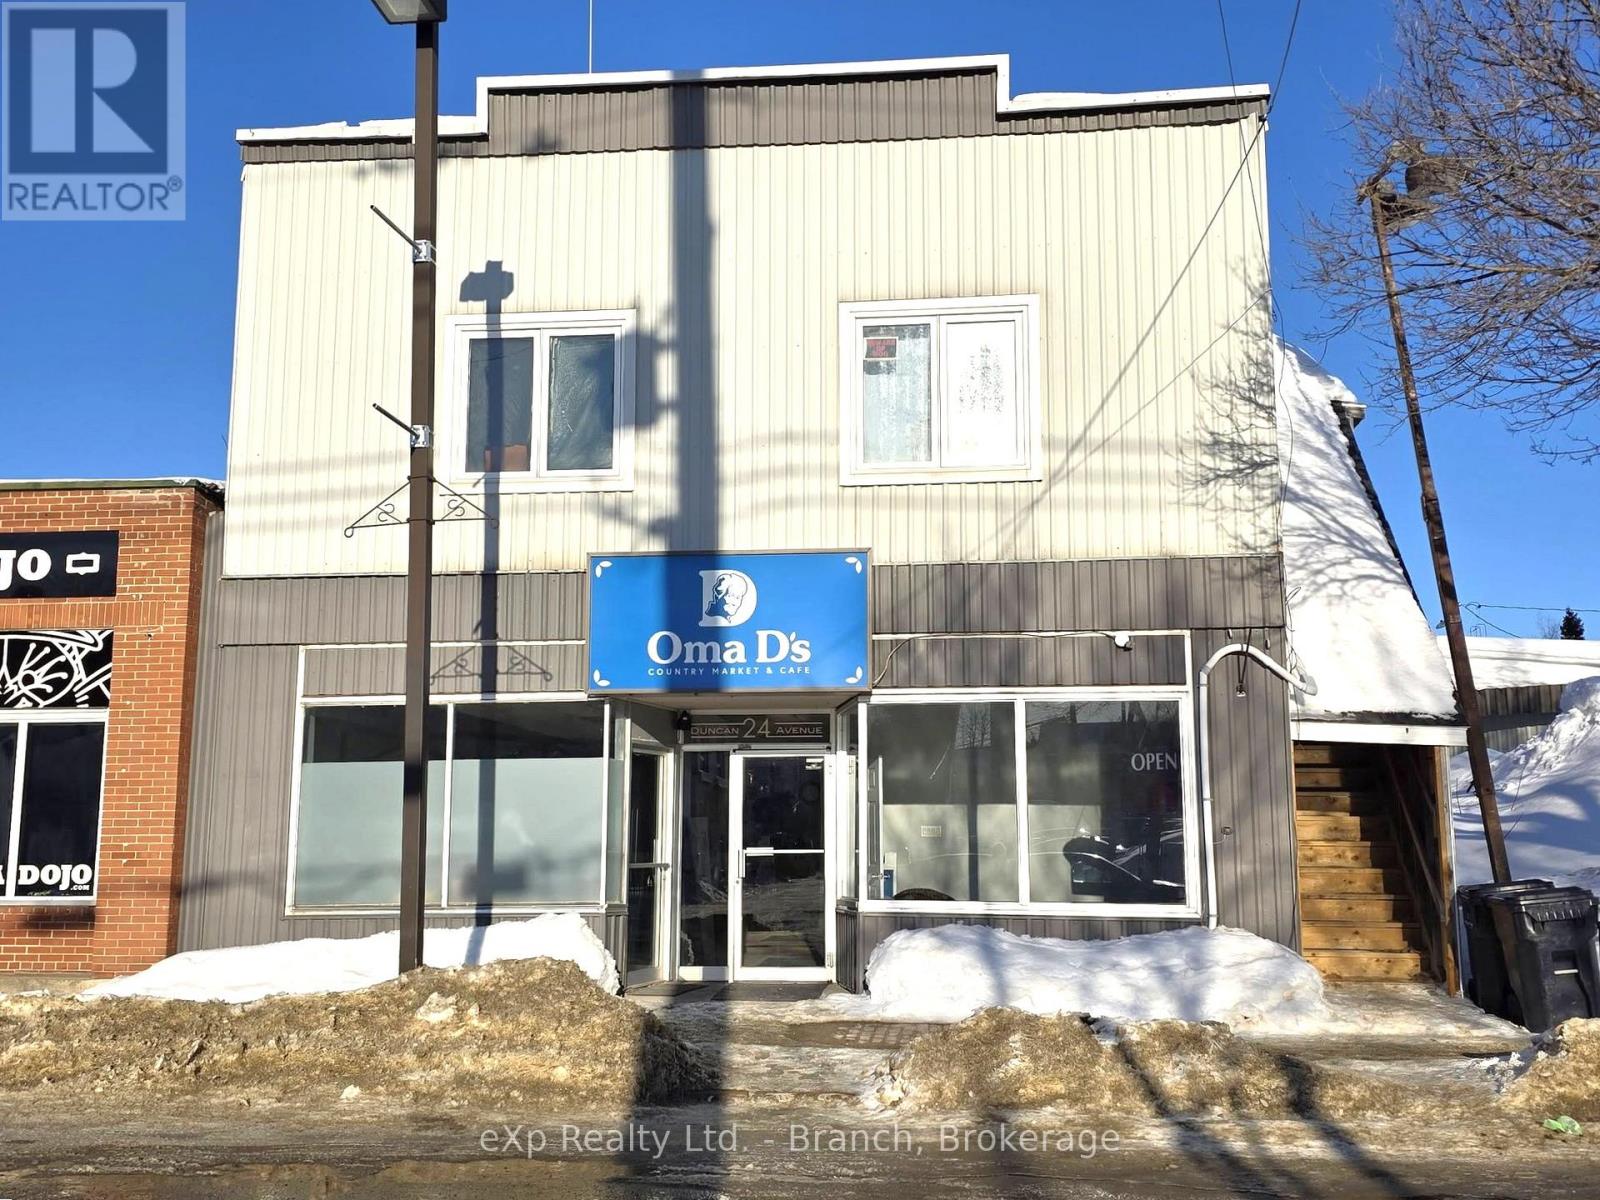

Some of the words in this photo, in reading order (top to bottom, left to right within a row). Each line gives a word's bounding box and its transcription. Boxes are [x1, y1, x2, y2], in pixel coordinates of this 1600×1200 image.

[647, 630, 747, 665] Oma
[755, 629, 811, 663] D's
[648, 667, 704, 676] COUNTRY
[712, 667, 759, 675] MARKET
[766, 667, 773, 675] &
[780, 666, 811, 674] CAFE
[690, 727, 739, 735] DUNCAN
[743, 718, 770, 738] 24
[775, 726, 823, 734] AVENUE
[1131, 752, 1178, 771] OPEN
[18, 864, 93, 891] DOJO
